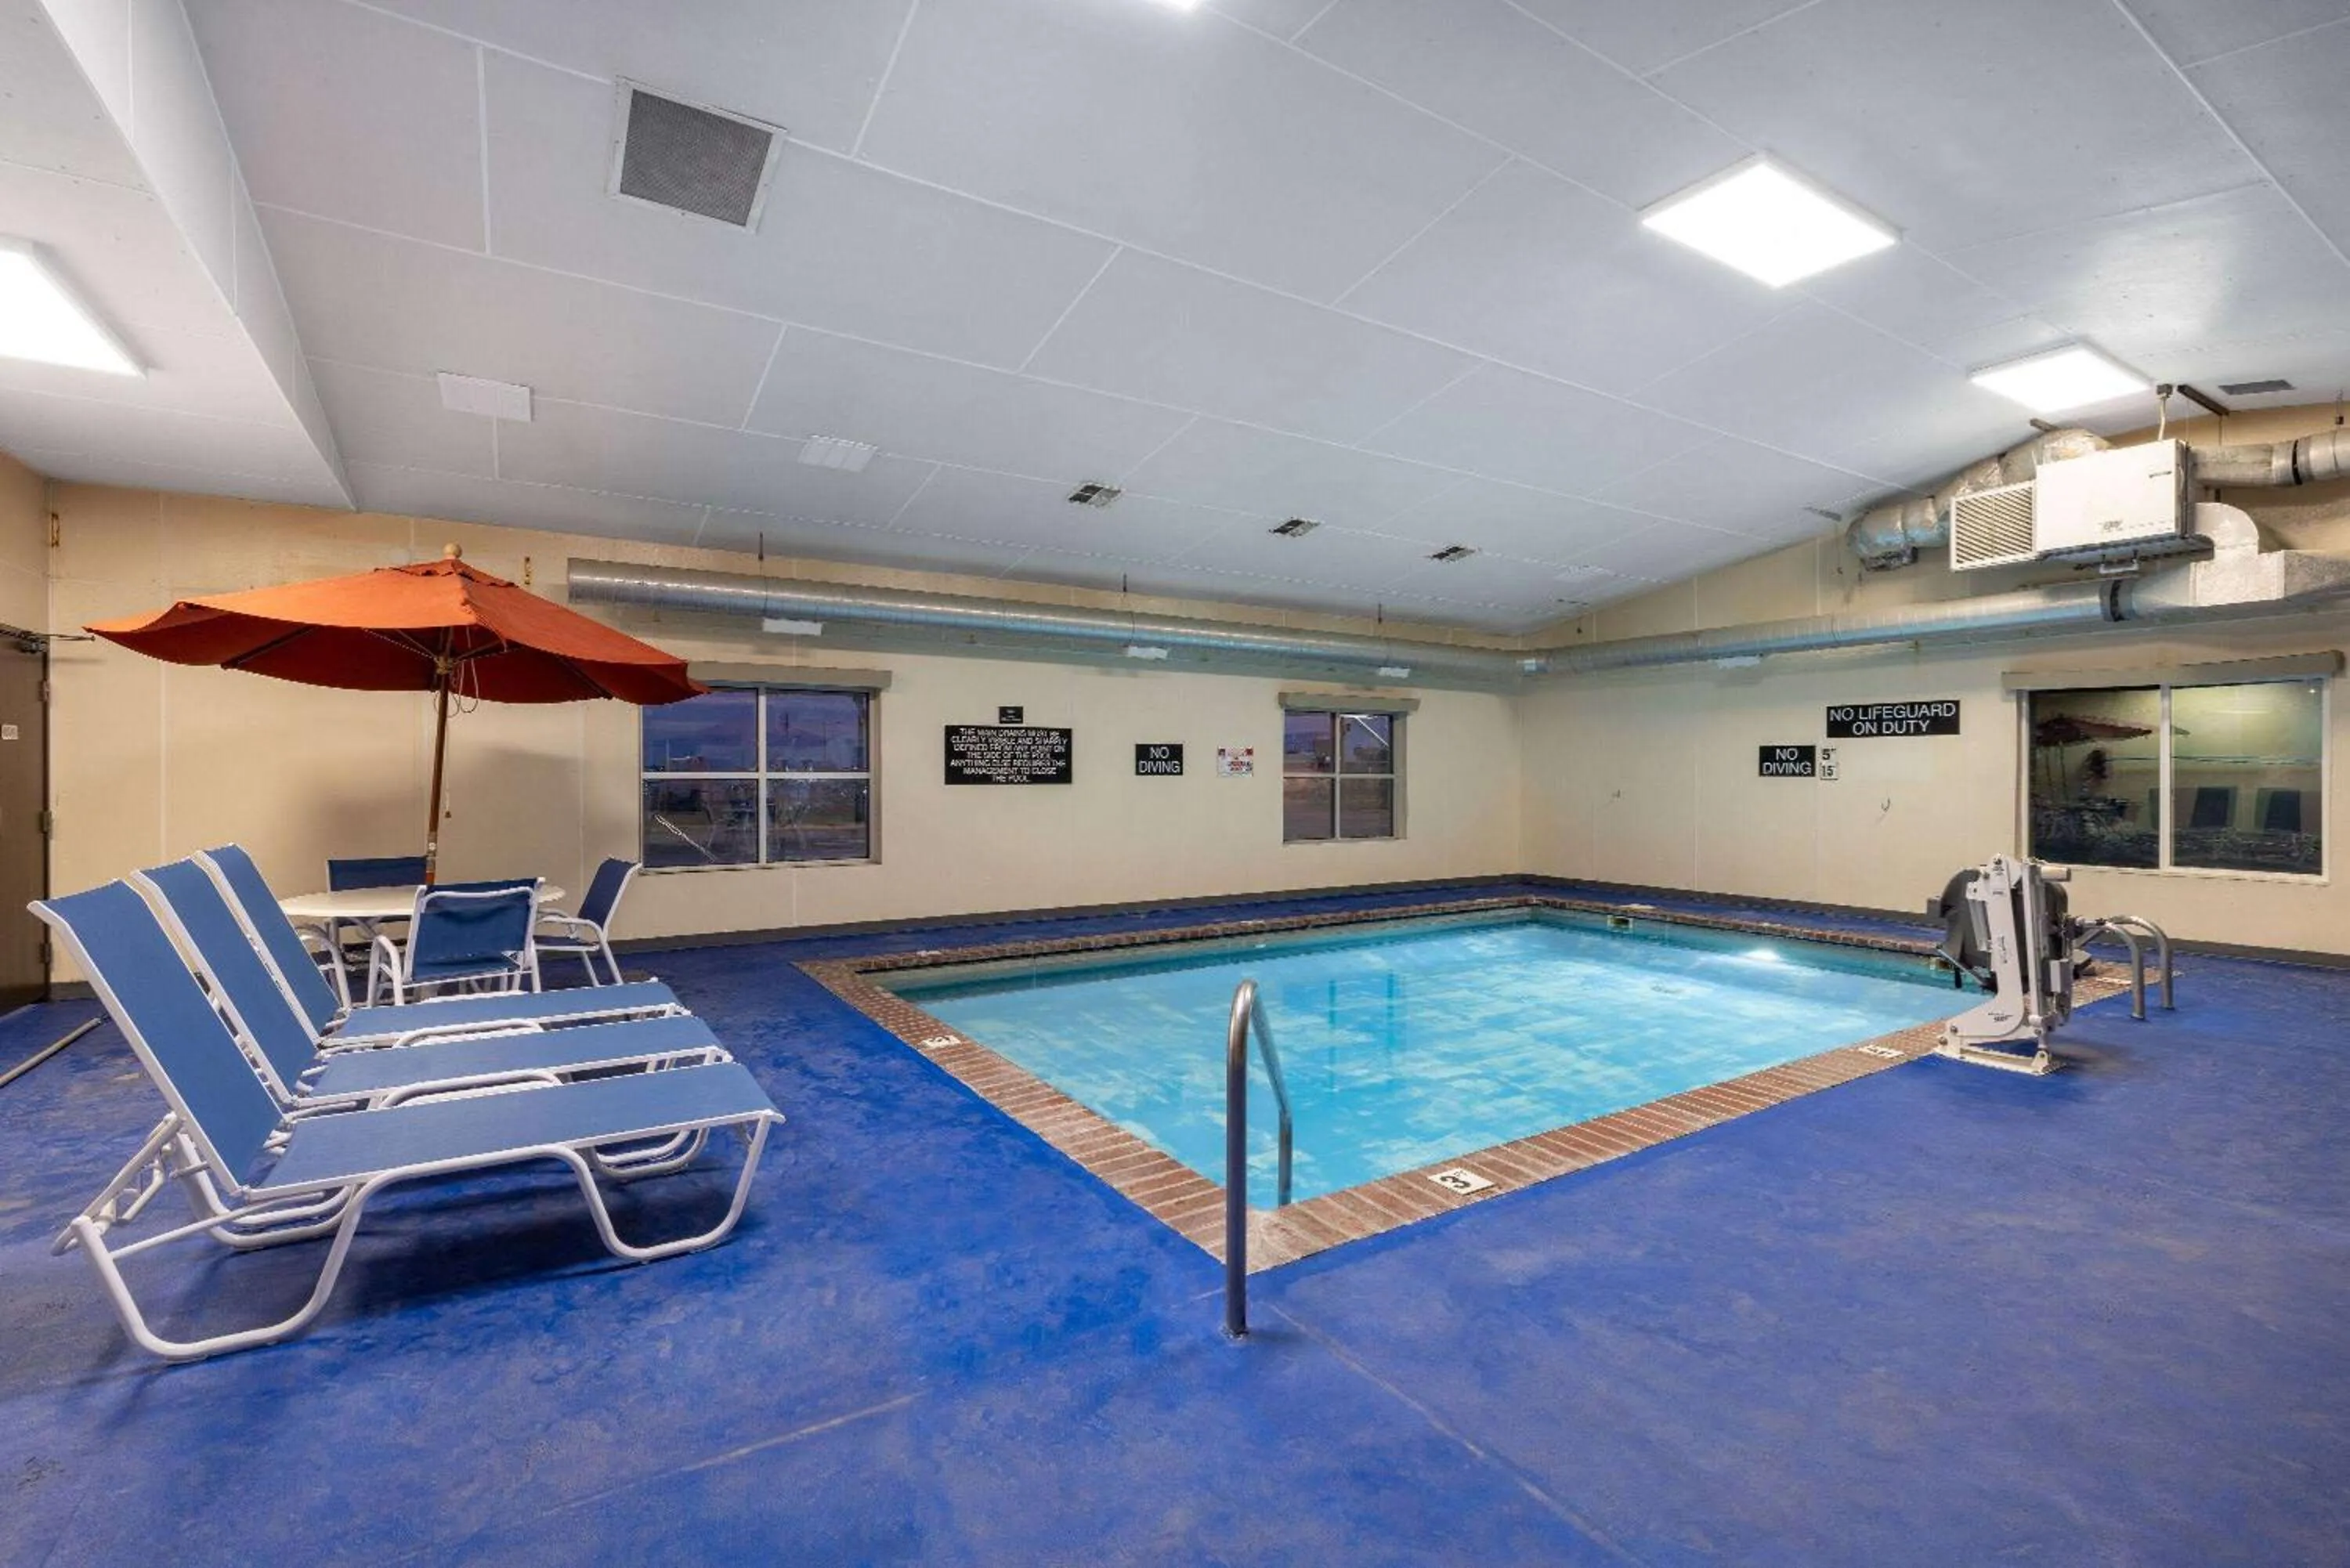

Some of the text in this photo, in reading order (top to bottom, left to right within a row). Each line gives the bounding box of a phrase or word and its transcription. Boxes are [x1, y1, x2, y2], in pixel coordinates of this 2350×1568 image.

[1829, 703, 1956, 721] NO LIFEGUARD
[960, 727, 976, 735] THE
[1853, 720, 1930, 735] ON DUTY
[1149, 746, 1170, 759] NO
[1775, 748, 1798, 761] NO
[1138, 761, 1180, 773] DIVING
[1762, 761, 1812, 775] DIVING
